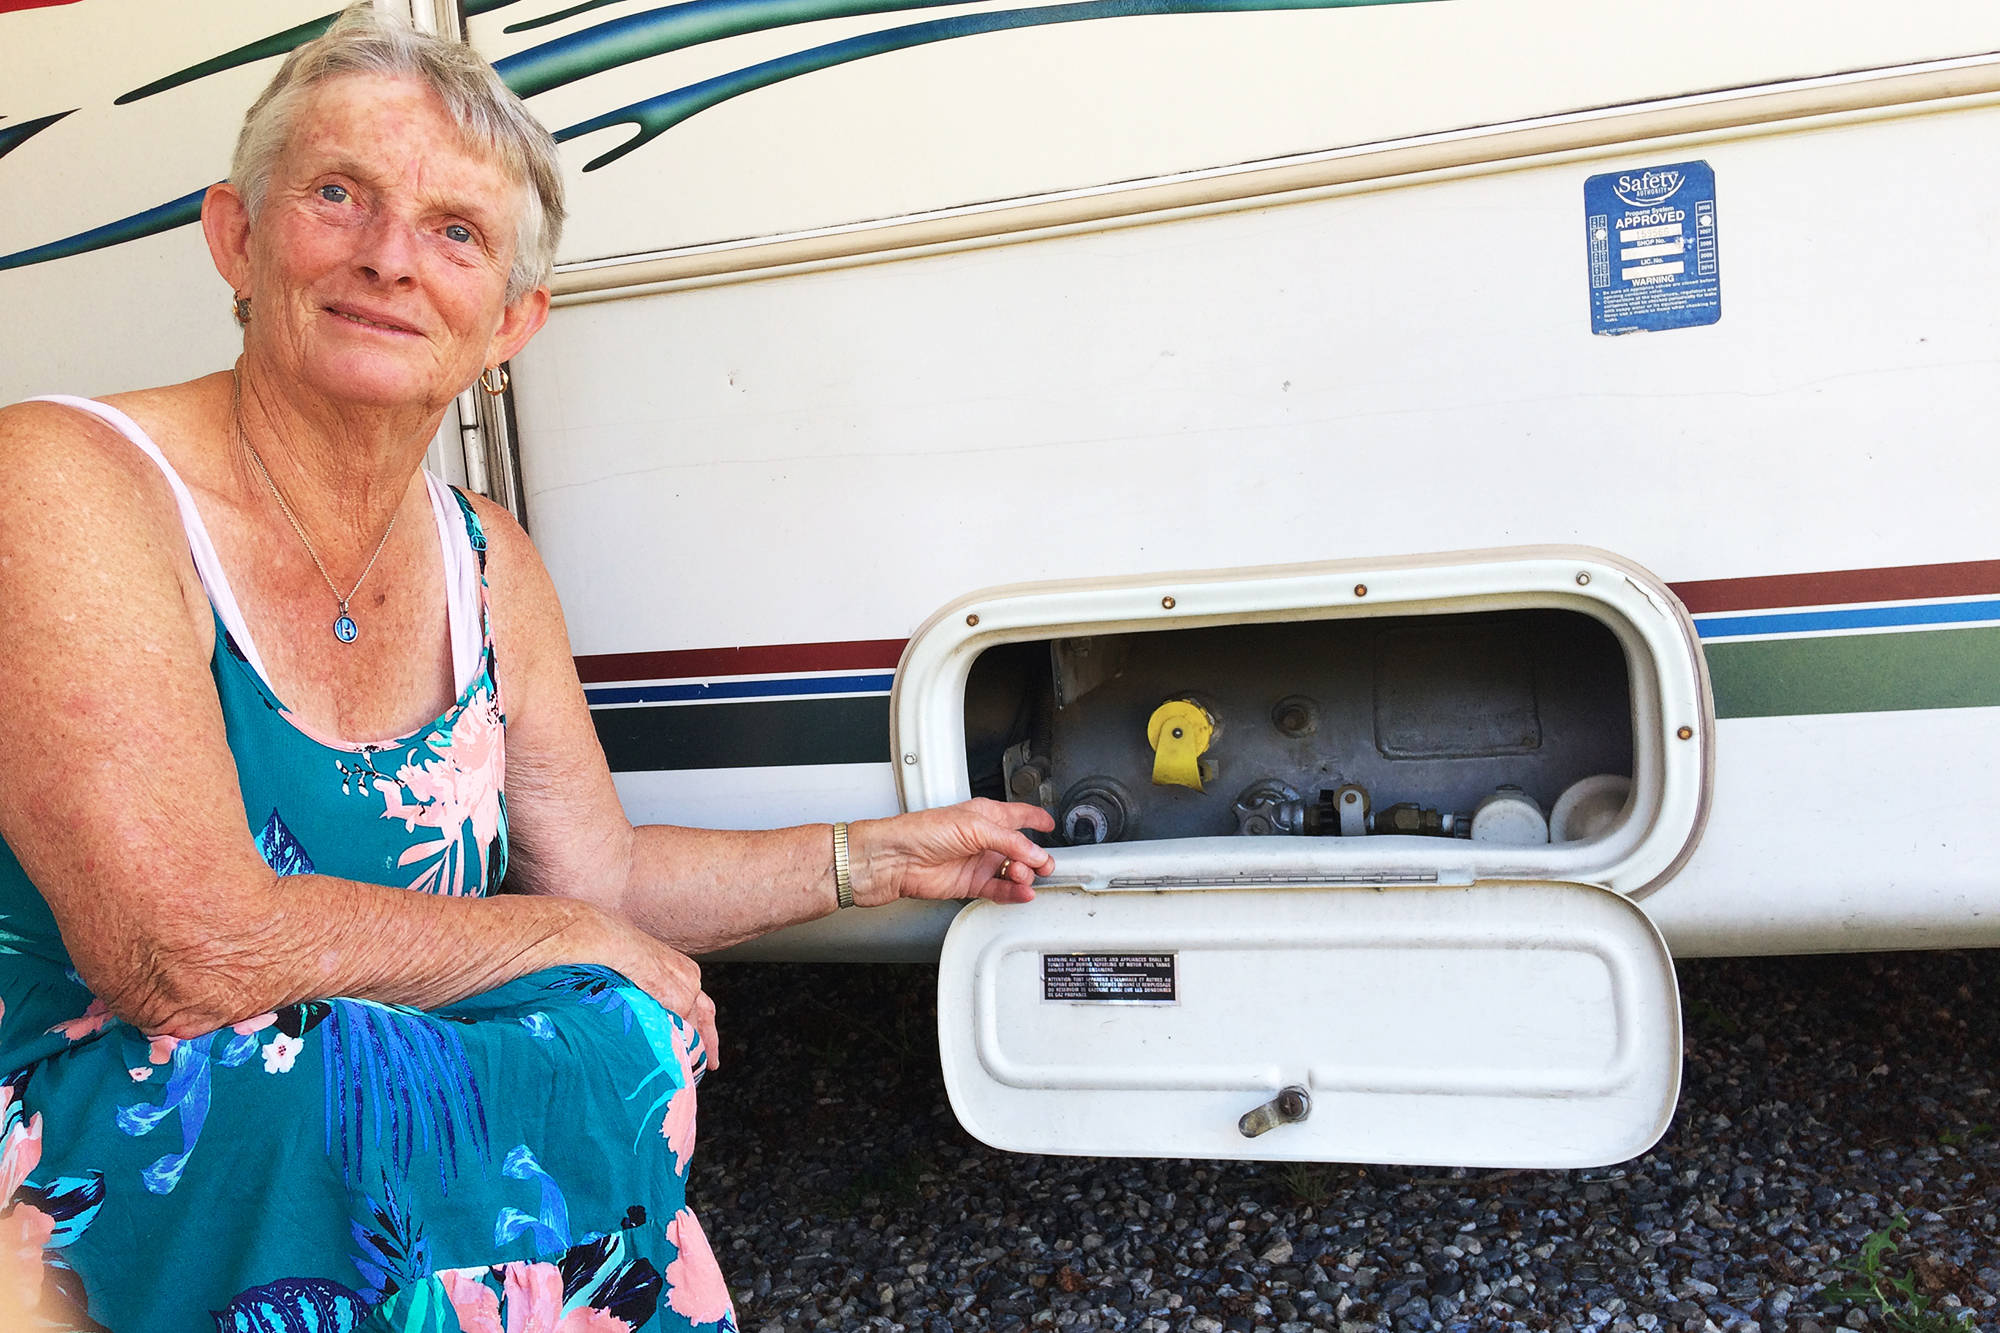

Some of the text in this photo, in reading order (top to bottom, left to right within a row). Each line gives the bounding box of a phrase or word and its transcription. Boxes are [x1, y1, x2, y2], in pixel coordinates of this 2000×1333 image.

[1619, 171, 1679, 193] Safety
[1637, 188, 1668, 197] AUTHORITY
[1625, 206, 1674, 218] Propane System
[1615, 210, 1685, 229] APPROVED
[1637, 239, 1654, 247] SHOP
[1632, 275, 1675, 287] WARNING
